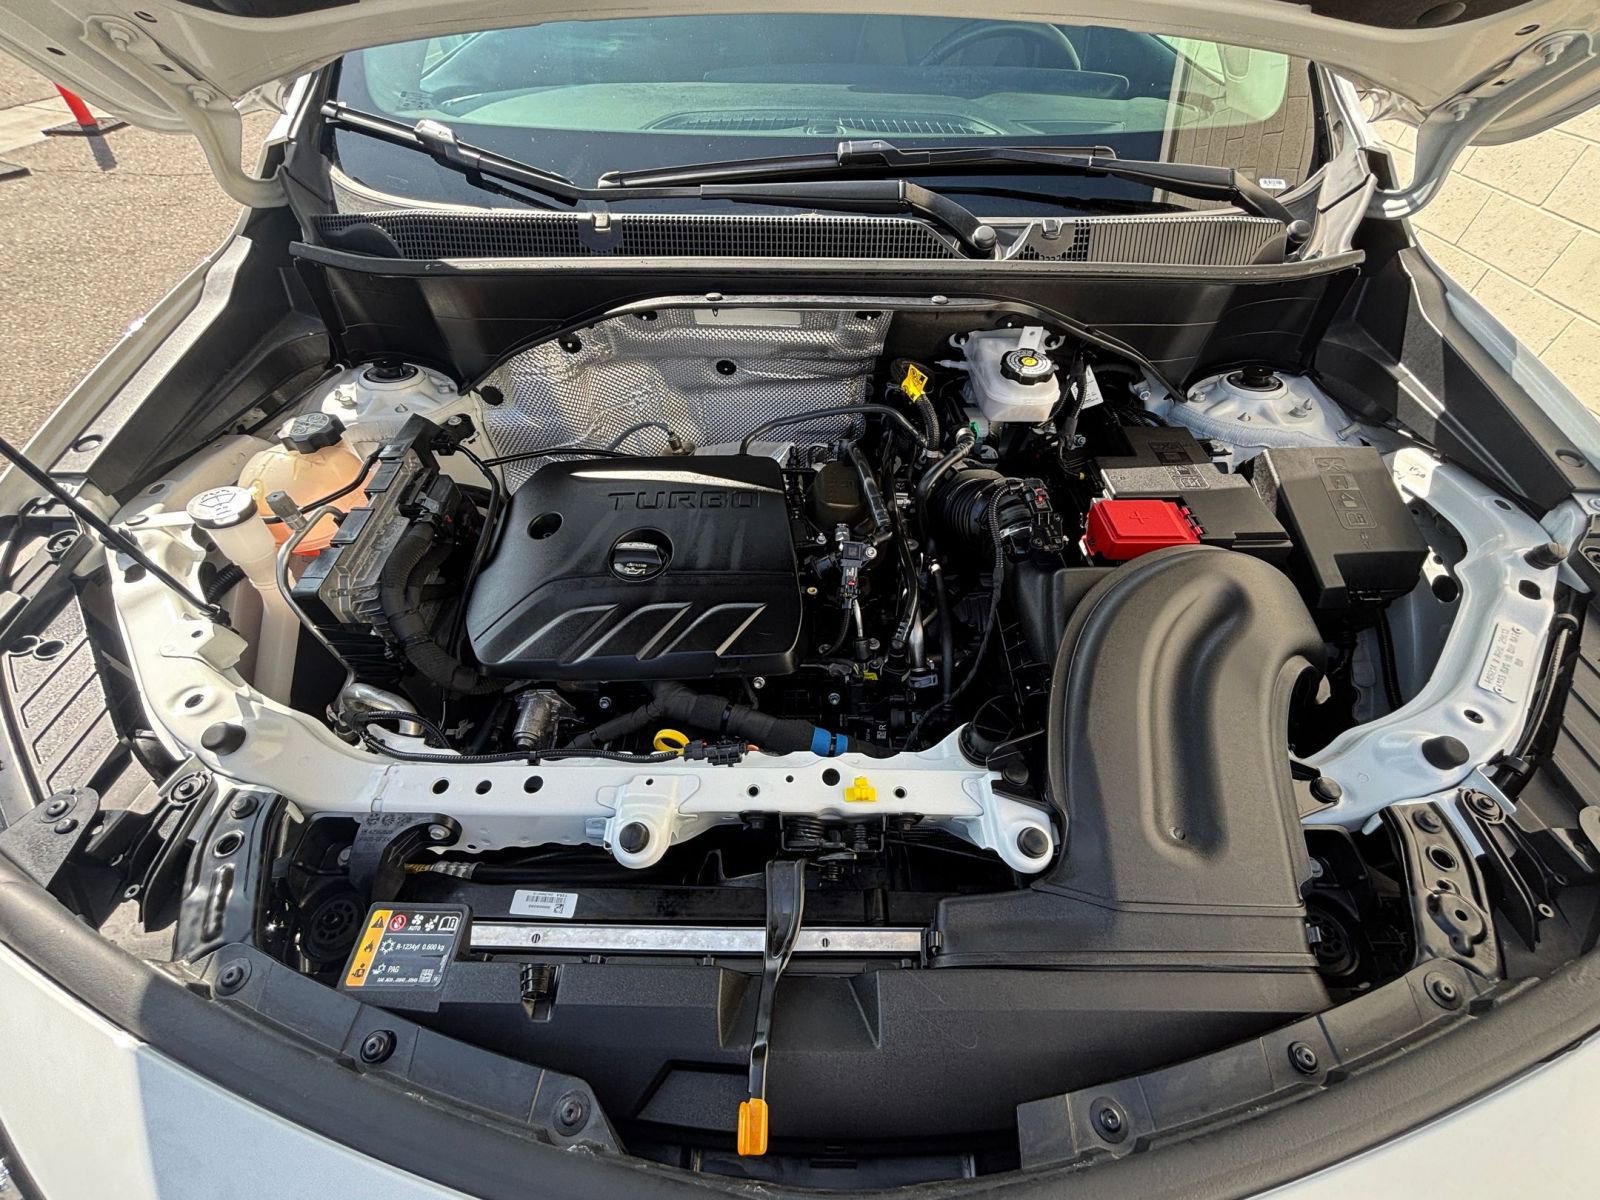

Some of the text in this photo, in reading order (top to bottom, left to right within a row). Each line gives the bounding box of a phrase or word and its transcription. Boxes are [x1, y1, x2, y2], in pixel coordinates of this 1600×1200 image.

[608, 491, 760, 510] TURBO
[437, 943, 445, 951] kg
[387, 965, 400, 973] PAG
